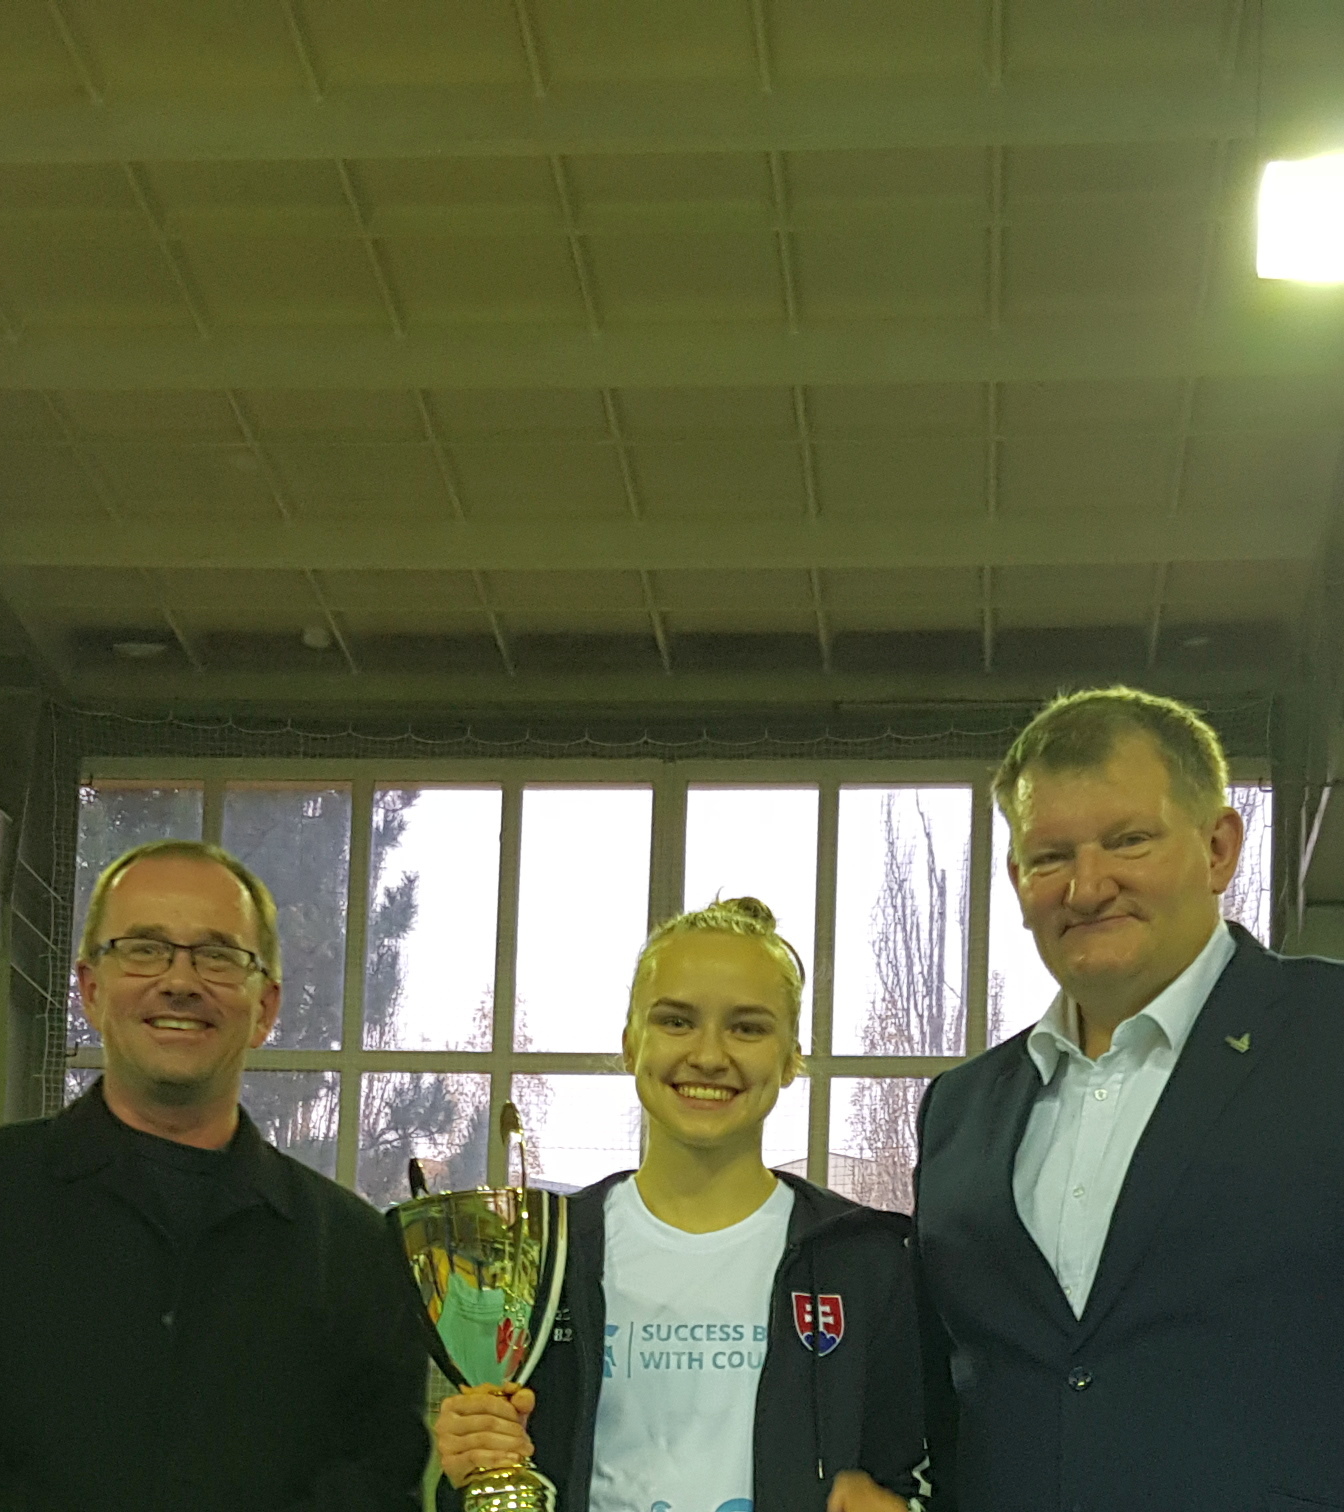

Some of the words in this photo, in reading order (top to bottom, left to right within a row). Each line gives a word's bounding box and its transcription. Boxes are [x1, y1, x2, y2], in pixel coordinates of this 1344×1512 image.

[641, 1323, 745, 1343] SUCCESS
[752, 1323, 768, 1342] B
[639, 1350, 704, 1370] WITH
[711, 1350, 763, 1370] COU
